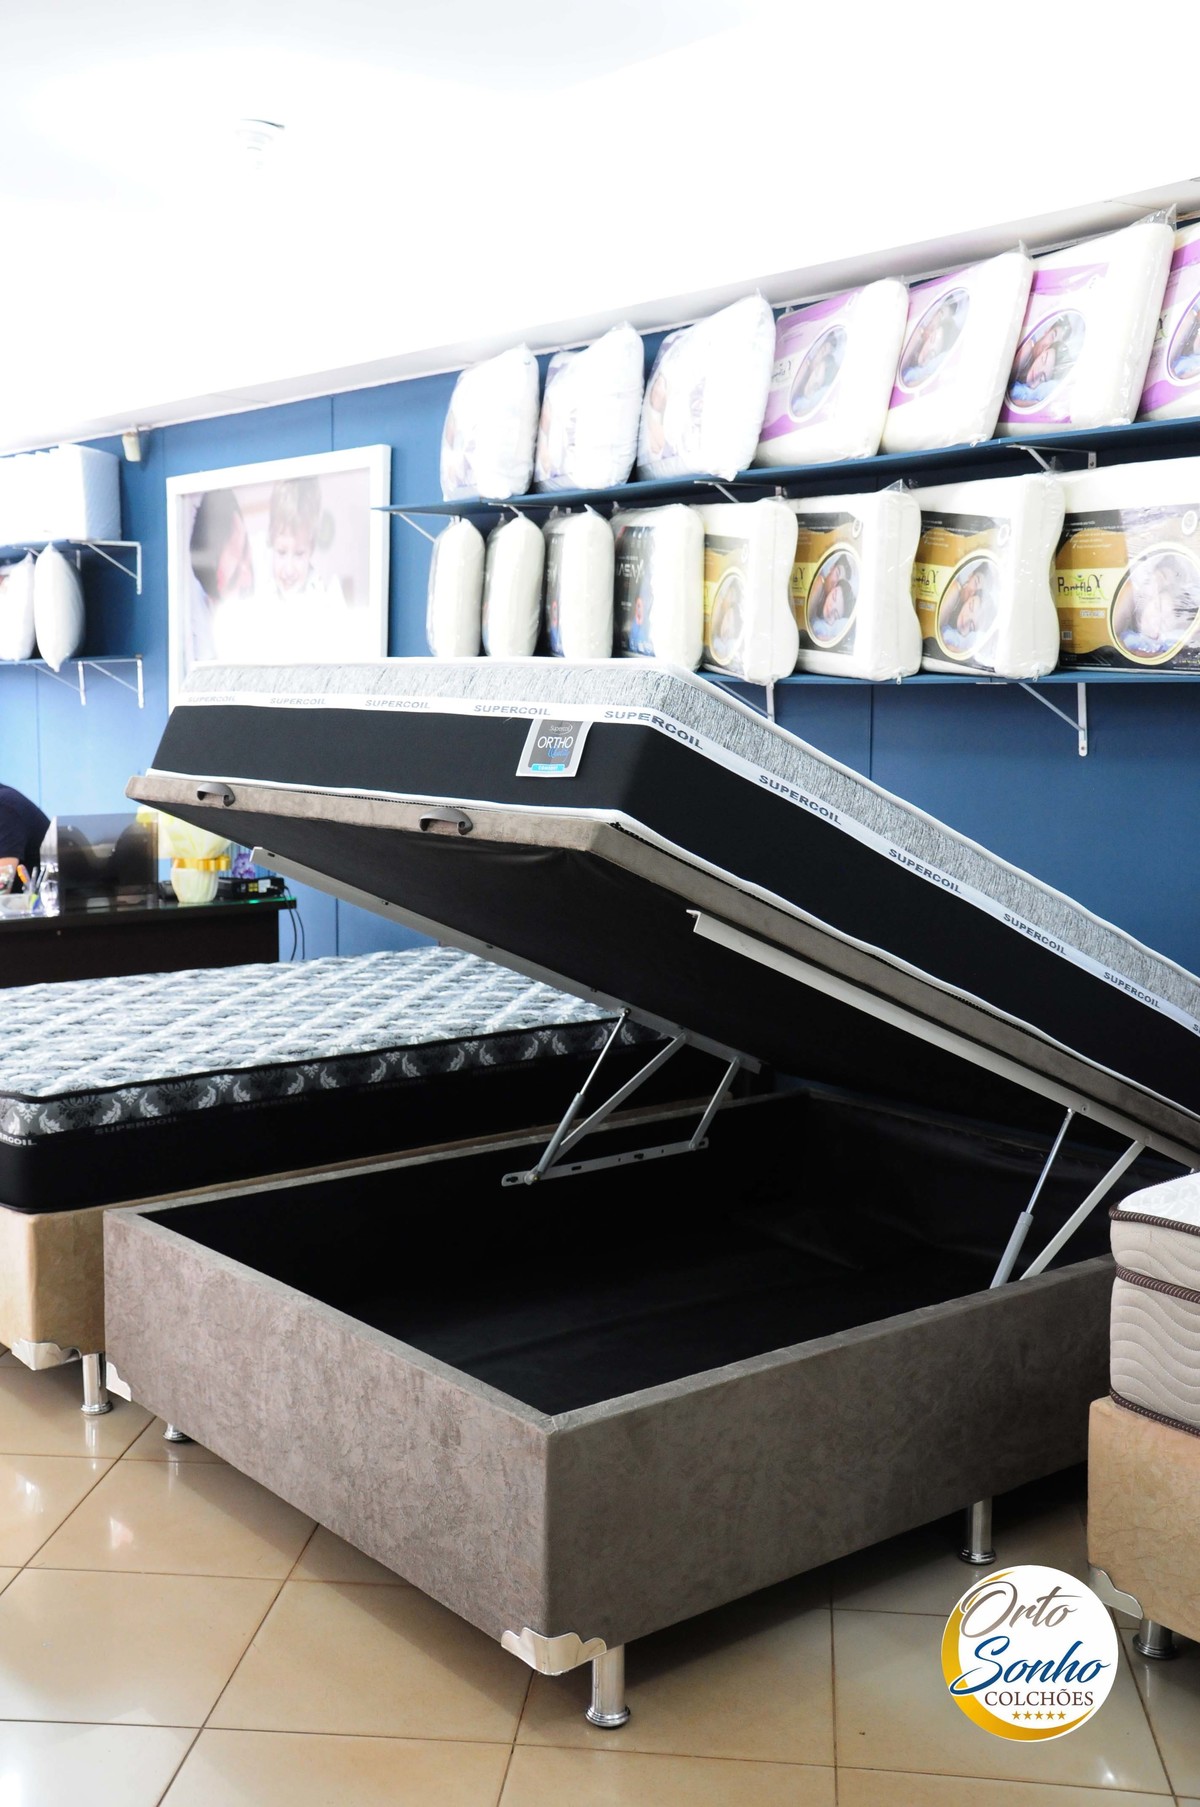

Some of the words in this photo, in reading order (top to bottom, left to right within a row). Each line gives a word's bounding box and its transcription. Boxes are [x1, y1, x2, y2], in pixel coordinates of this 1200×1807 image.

[187, 695, 236, 703] SUPERCOIL
[270, 697, 326, 705] SUPERCOIL
[365, 699, 431, 709] SUPERCOIL
[474, 704, 551, 716] SUPERCOIL
[604, 710, 703, 750] SUPERCOIL
[537, 736, 574, 749] ORTHO
[759, 774, 842, 825] SUPERCOIL
[889, 848, 962, 894] SUPERCOIL
[1003, 913, 1067, 956] SUPERCOIL
[1103, 971, 1161, 1009] SUPERCOIL
[94, 1116, 179, 1135] SUPERCOIL
